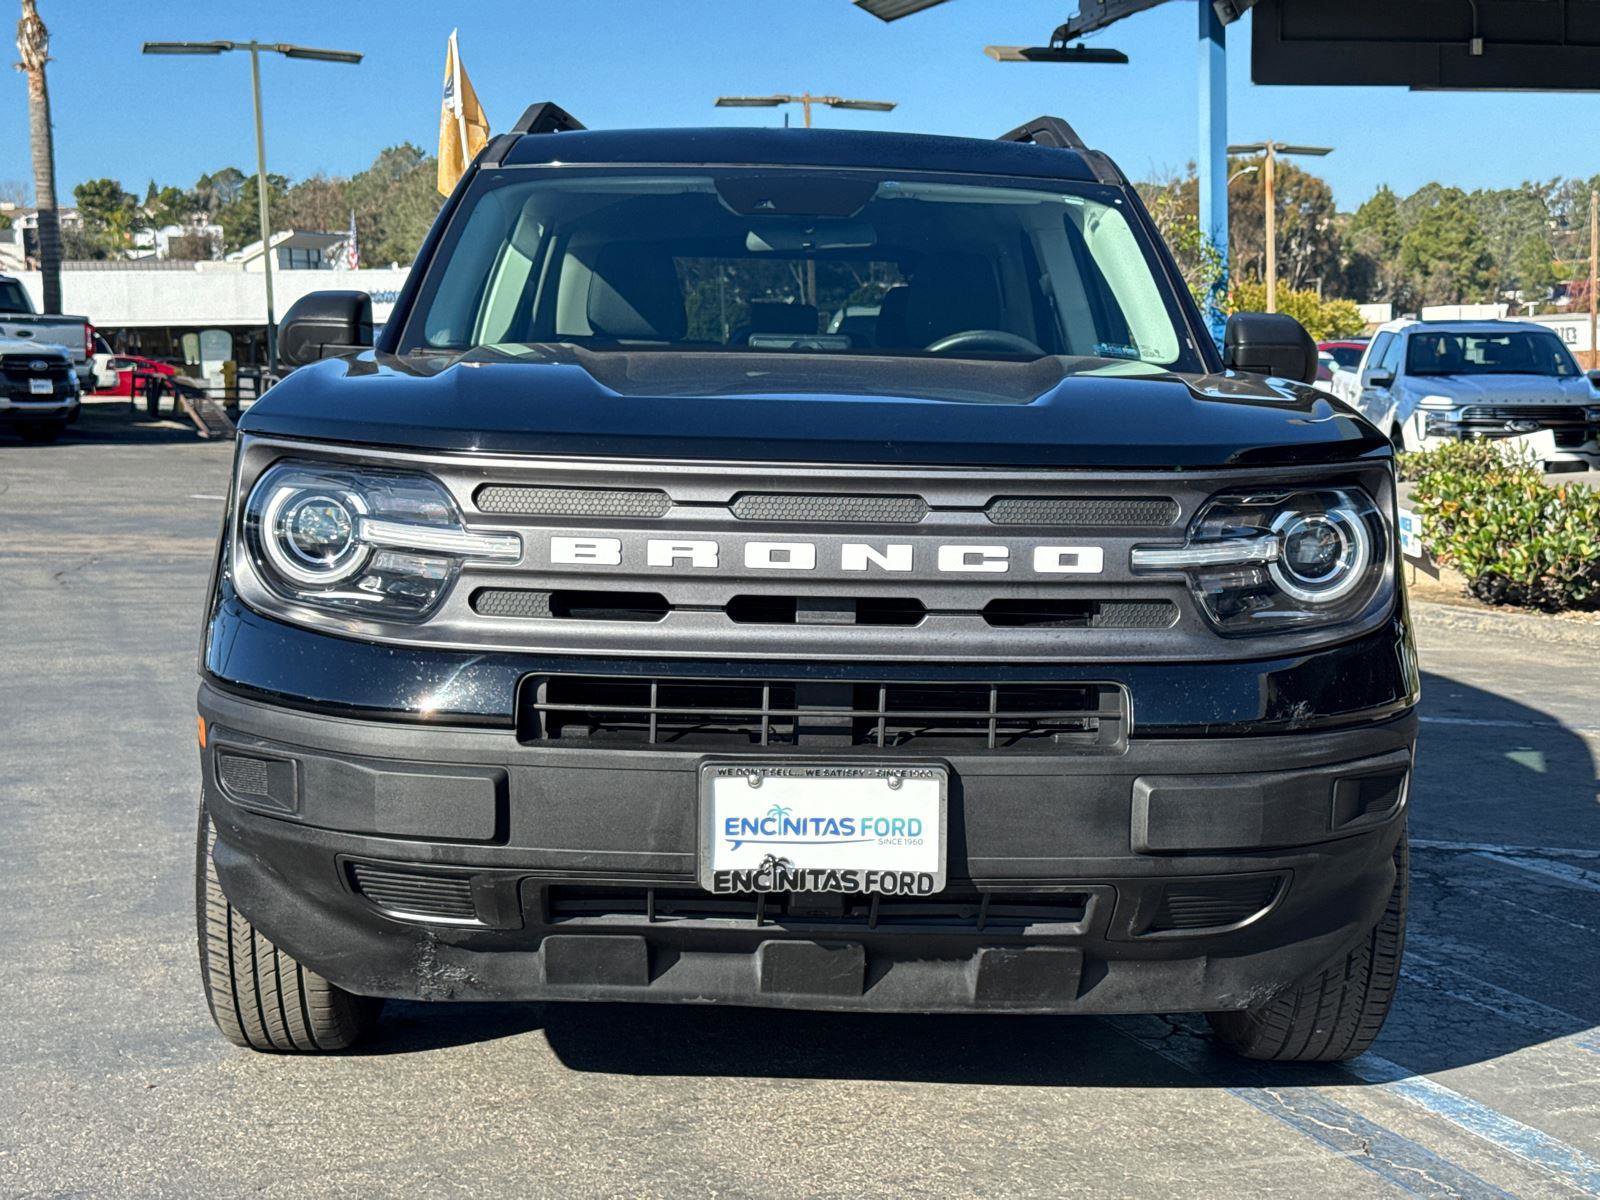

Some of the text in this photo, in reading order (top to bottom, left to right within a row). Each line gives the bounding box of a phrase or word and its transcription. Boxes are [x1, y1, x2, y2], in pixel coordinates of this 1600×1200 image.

[550, 536, 1105, 573] BRONCO
[717, 768, 733, 776] WE
[736, 768, 767, 777] DON'T
[805, 769, 820, 777] WE
[823, 769, 865, 777] SATISFY
[877, 769, 907, 778] SINCE
[724, 815, 923, 837] ENCINITAS FORD
[878, 838, 924, 846] SINCE 1960
[713, 868, 934, 895] ENCINITAS FORD
